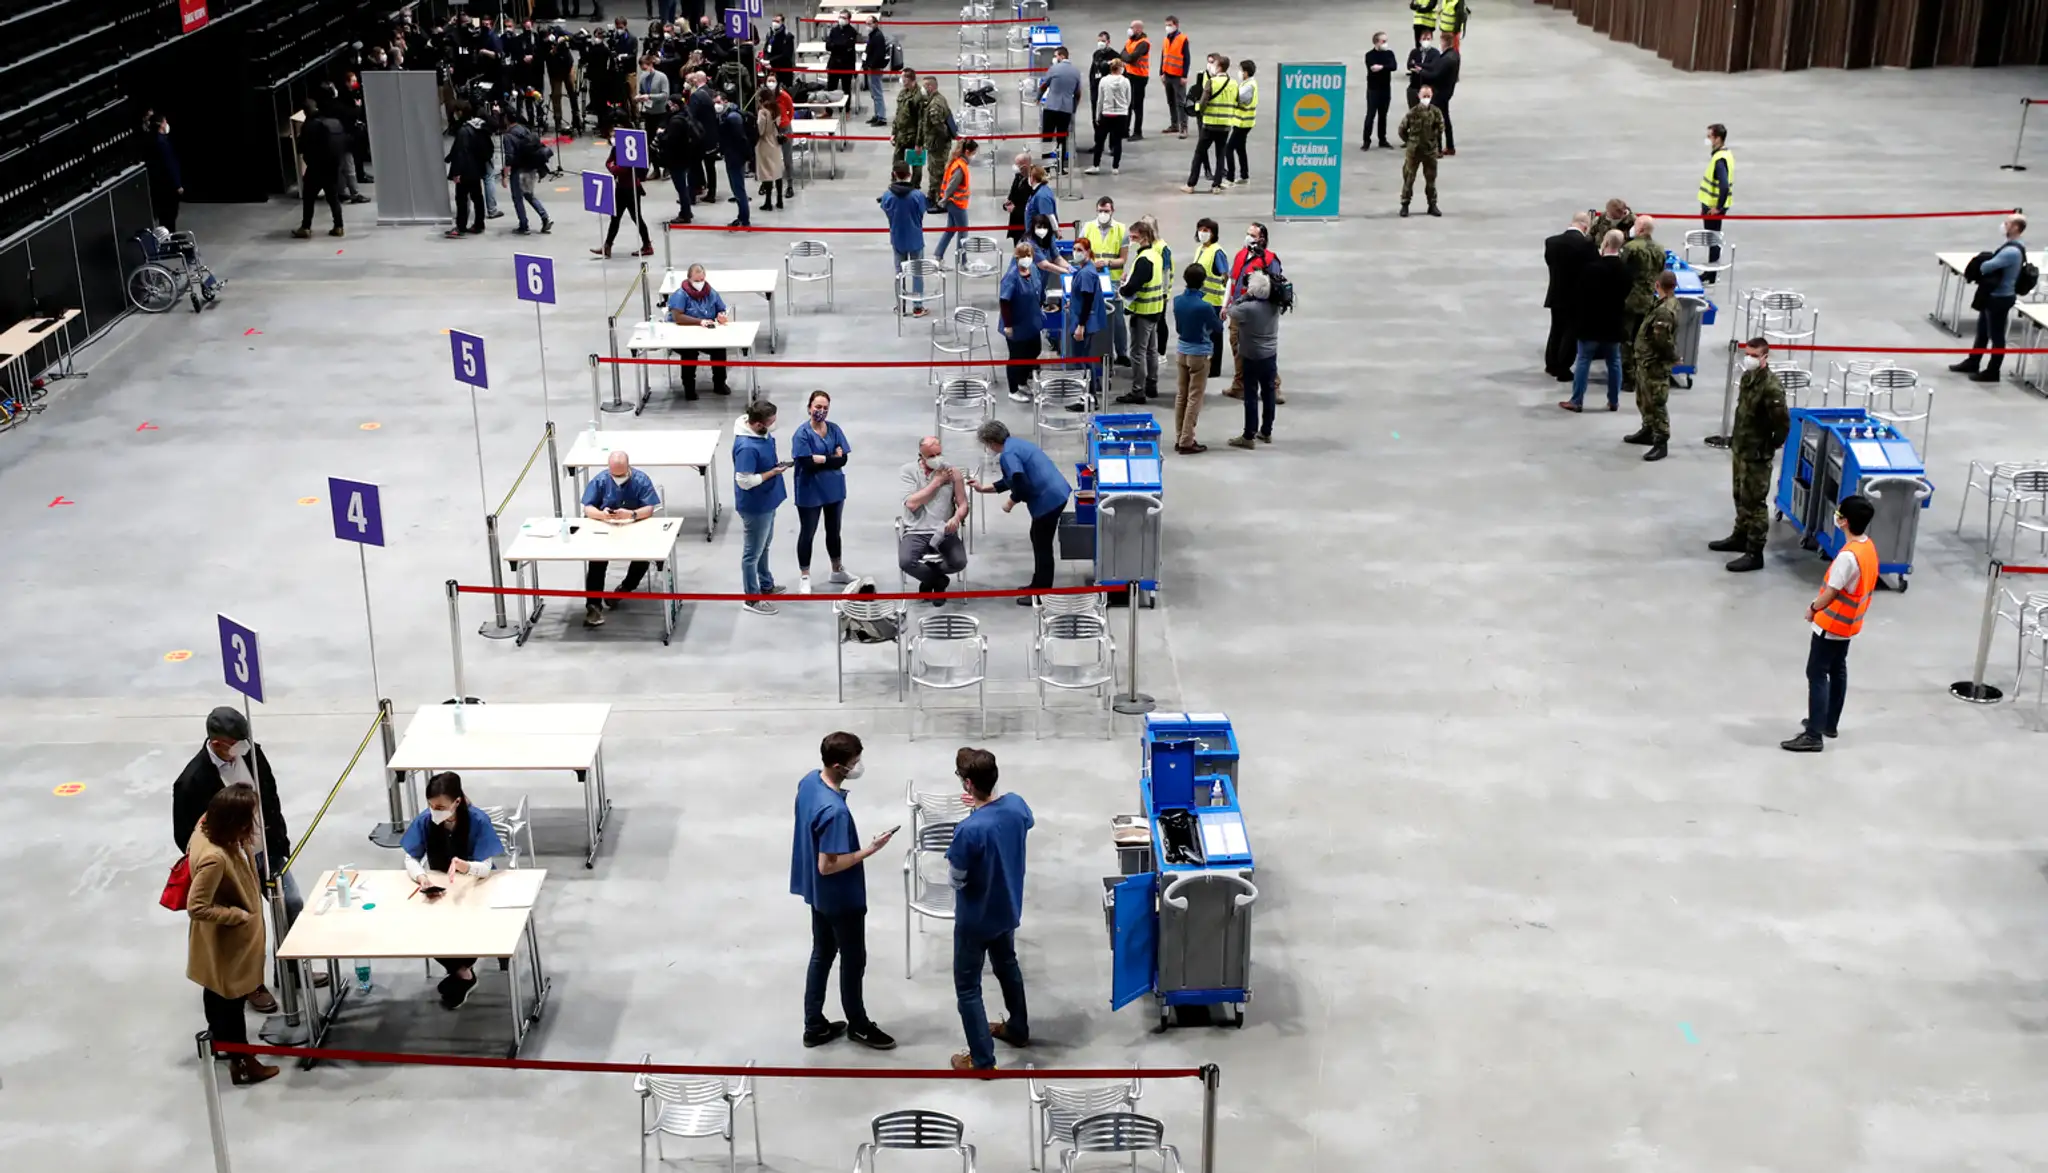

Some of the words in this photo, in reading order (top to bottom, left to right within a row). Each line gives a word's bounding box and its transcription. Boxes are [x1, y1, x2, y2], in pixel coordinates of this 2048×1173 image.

[732, 14, 742, 34] 9
[1285, 70, 1341, 90] VÝCHOD
[624, 135, 638, 162] 8
[1282, 156, 1295, 167] PO
[592, 178, 604, 207] 7
[527, 262, 544, 295] 6
[461, 340, 476, 377] 5
[347, 491, 368, 533] 4
[231, 633, 249, 683] 3
